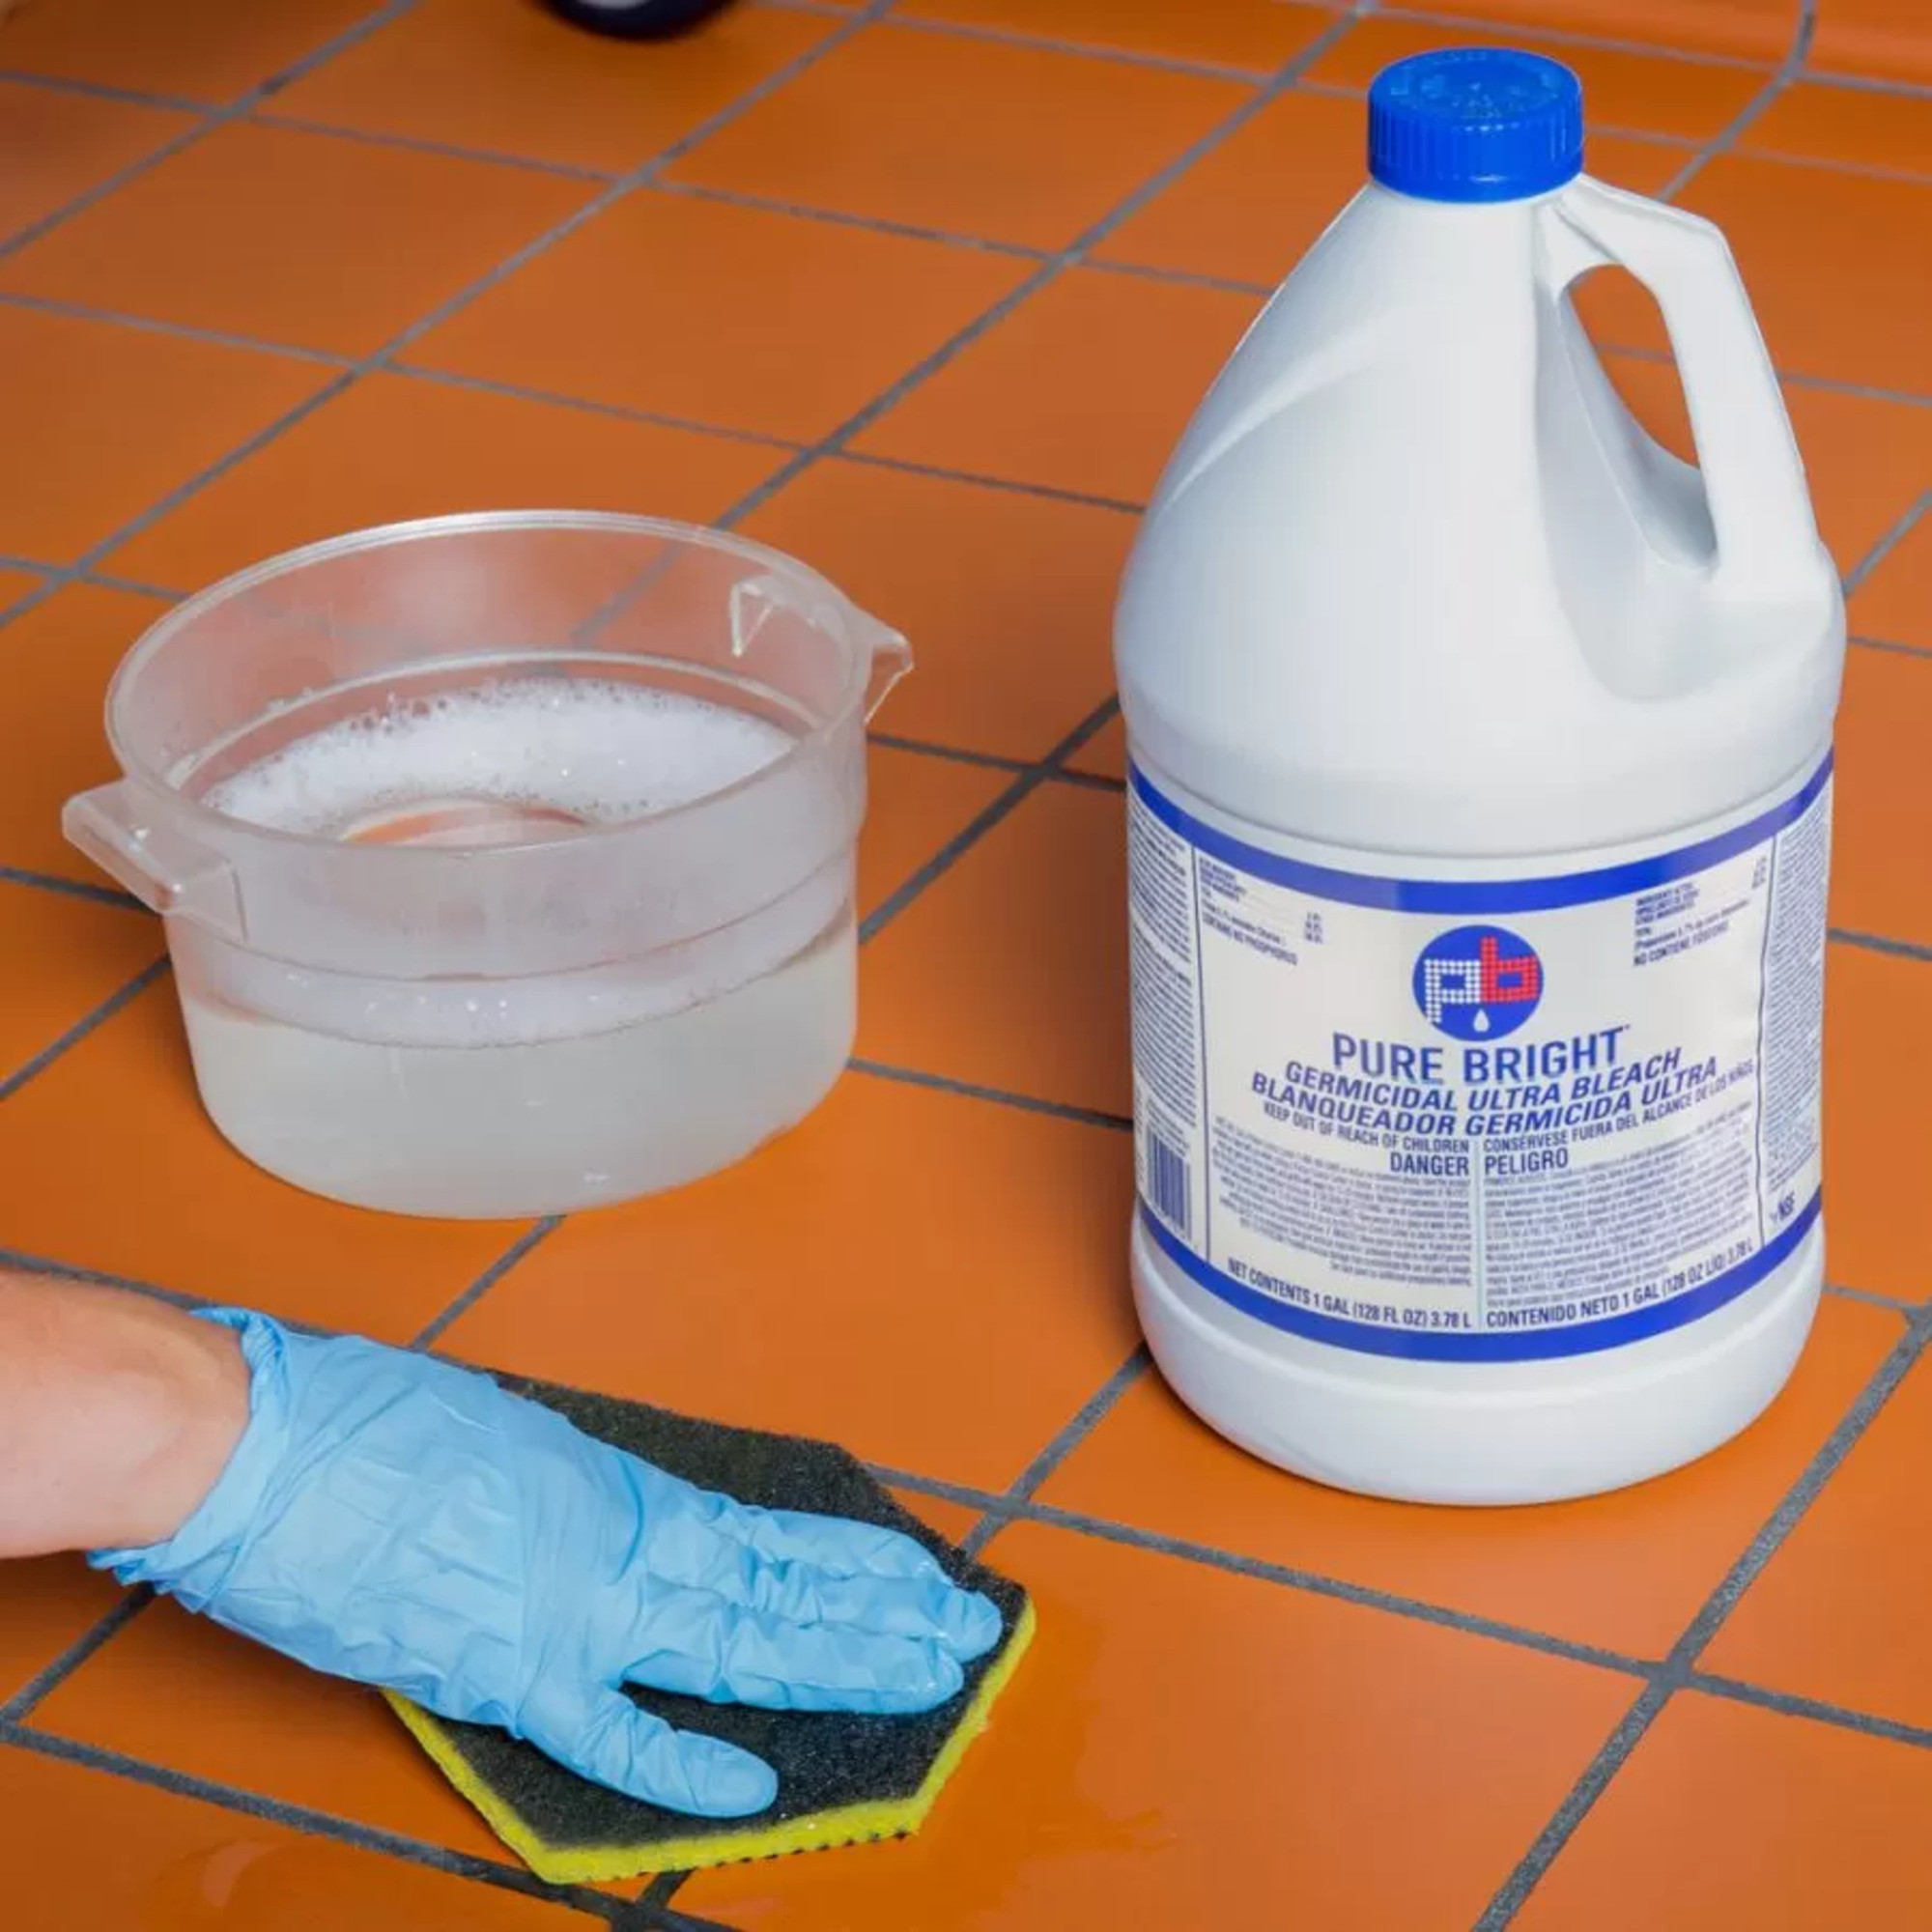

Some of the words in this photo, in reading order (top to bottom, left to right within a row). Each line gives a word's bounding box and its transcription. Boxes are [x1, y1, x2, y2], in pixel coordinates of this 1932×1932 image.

[1285, 1061, 1458, 1112] GERMICIDAL
[1467, 1083, 1560, 1112] ULTRA
[1571, 1047, 1682, 1100] BLEACH
[1332, 1032, 1444, 1085] PURE
[1252, 1071, 1456, 1136] BLANQUEADOR
[1465, 1091, 1633, 1137] GERMICIDA
[1641, 1056, 1717, 1106] ULTRA
[1264, 1100, 1290, 1121] KEEP
[1293, 1112, 1315, 1131] OUT
[1319, 1121, 1334, 1136] OF
[1338, 1125, 1378, 1147] REACH
[1382, 1135, 1399, 1150] OF
[1403, 1137, 1469, 1153] CHILDREN
[1572, 1117, 1612, 1141] FUERA
[1616, 1114, 1637, 1131] DEL
[1643, 1093, 1691, 1123] ALCANCE
[1695, 1086, 1708, 1102] DE
[1709, 1073, 1726, 1095] LOS
[1390, 1151, 1469, 1176] DANGER
[1485, 1148, 1568, 1176] PELIGRO
[1228, 1257, 1247, 1279] NET
[1249, 1267, 1310, 1304] CONTENTS
[1314, 1293, 1320, 1307] 1
[1322, 1294, 1350, 1315] GAL
[1353, 1303, 1380, 1323] (128
[1384, 1308, 1400, 1323] FL
[1404, 1311, 1429, 1327] OZ)
[1431, 1311, 1461, 1328] 3.78
[1463, 1313, 1471, 1328] L
[1486, 1303, 1577, 1328] CONTENIDO
[1580, 1294, 1620, 1317] NETO
[1623, 1293, 1630, 1308] 1
[1633, 1283, 1660, 1304] GAL
[1662, 1271, 1686, 1296] (128
[1688, 1264, 1703, 1284] OZ
